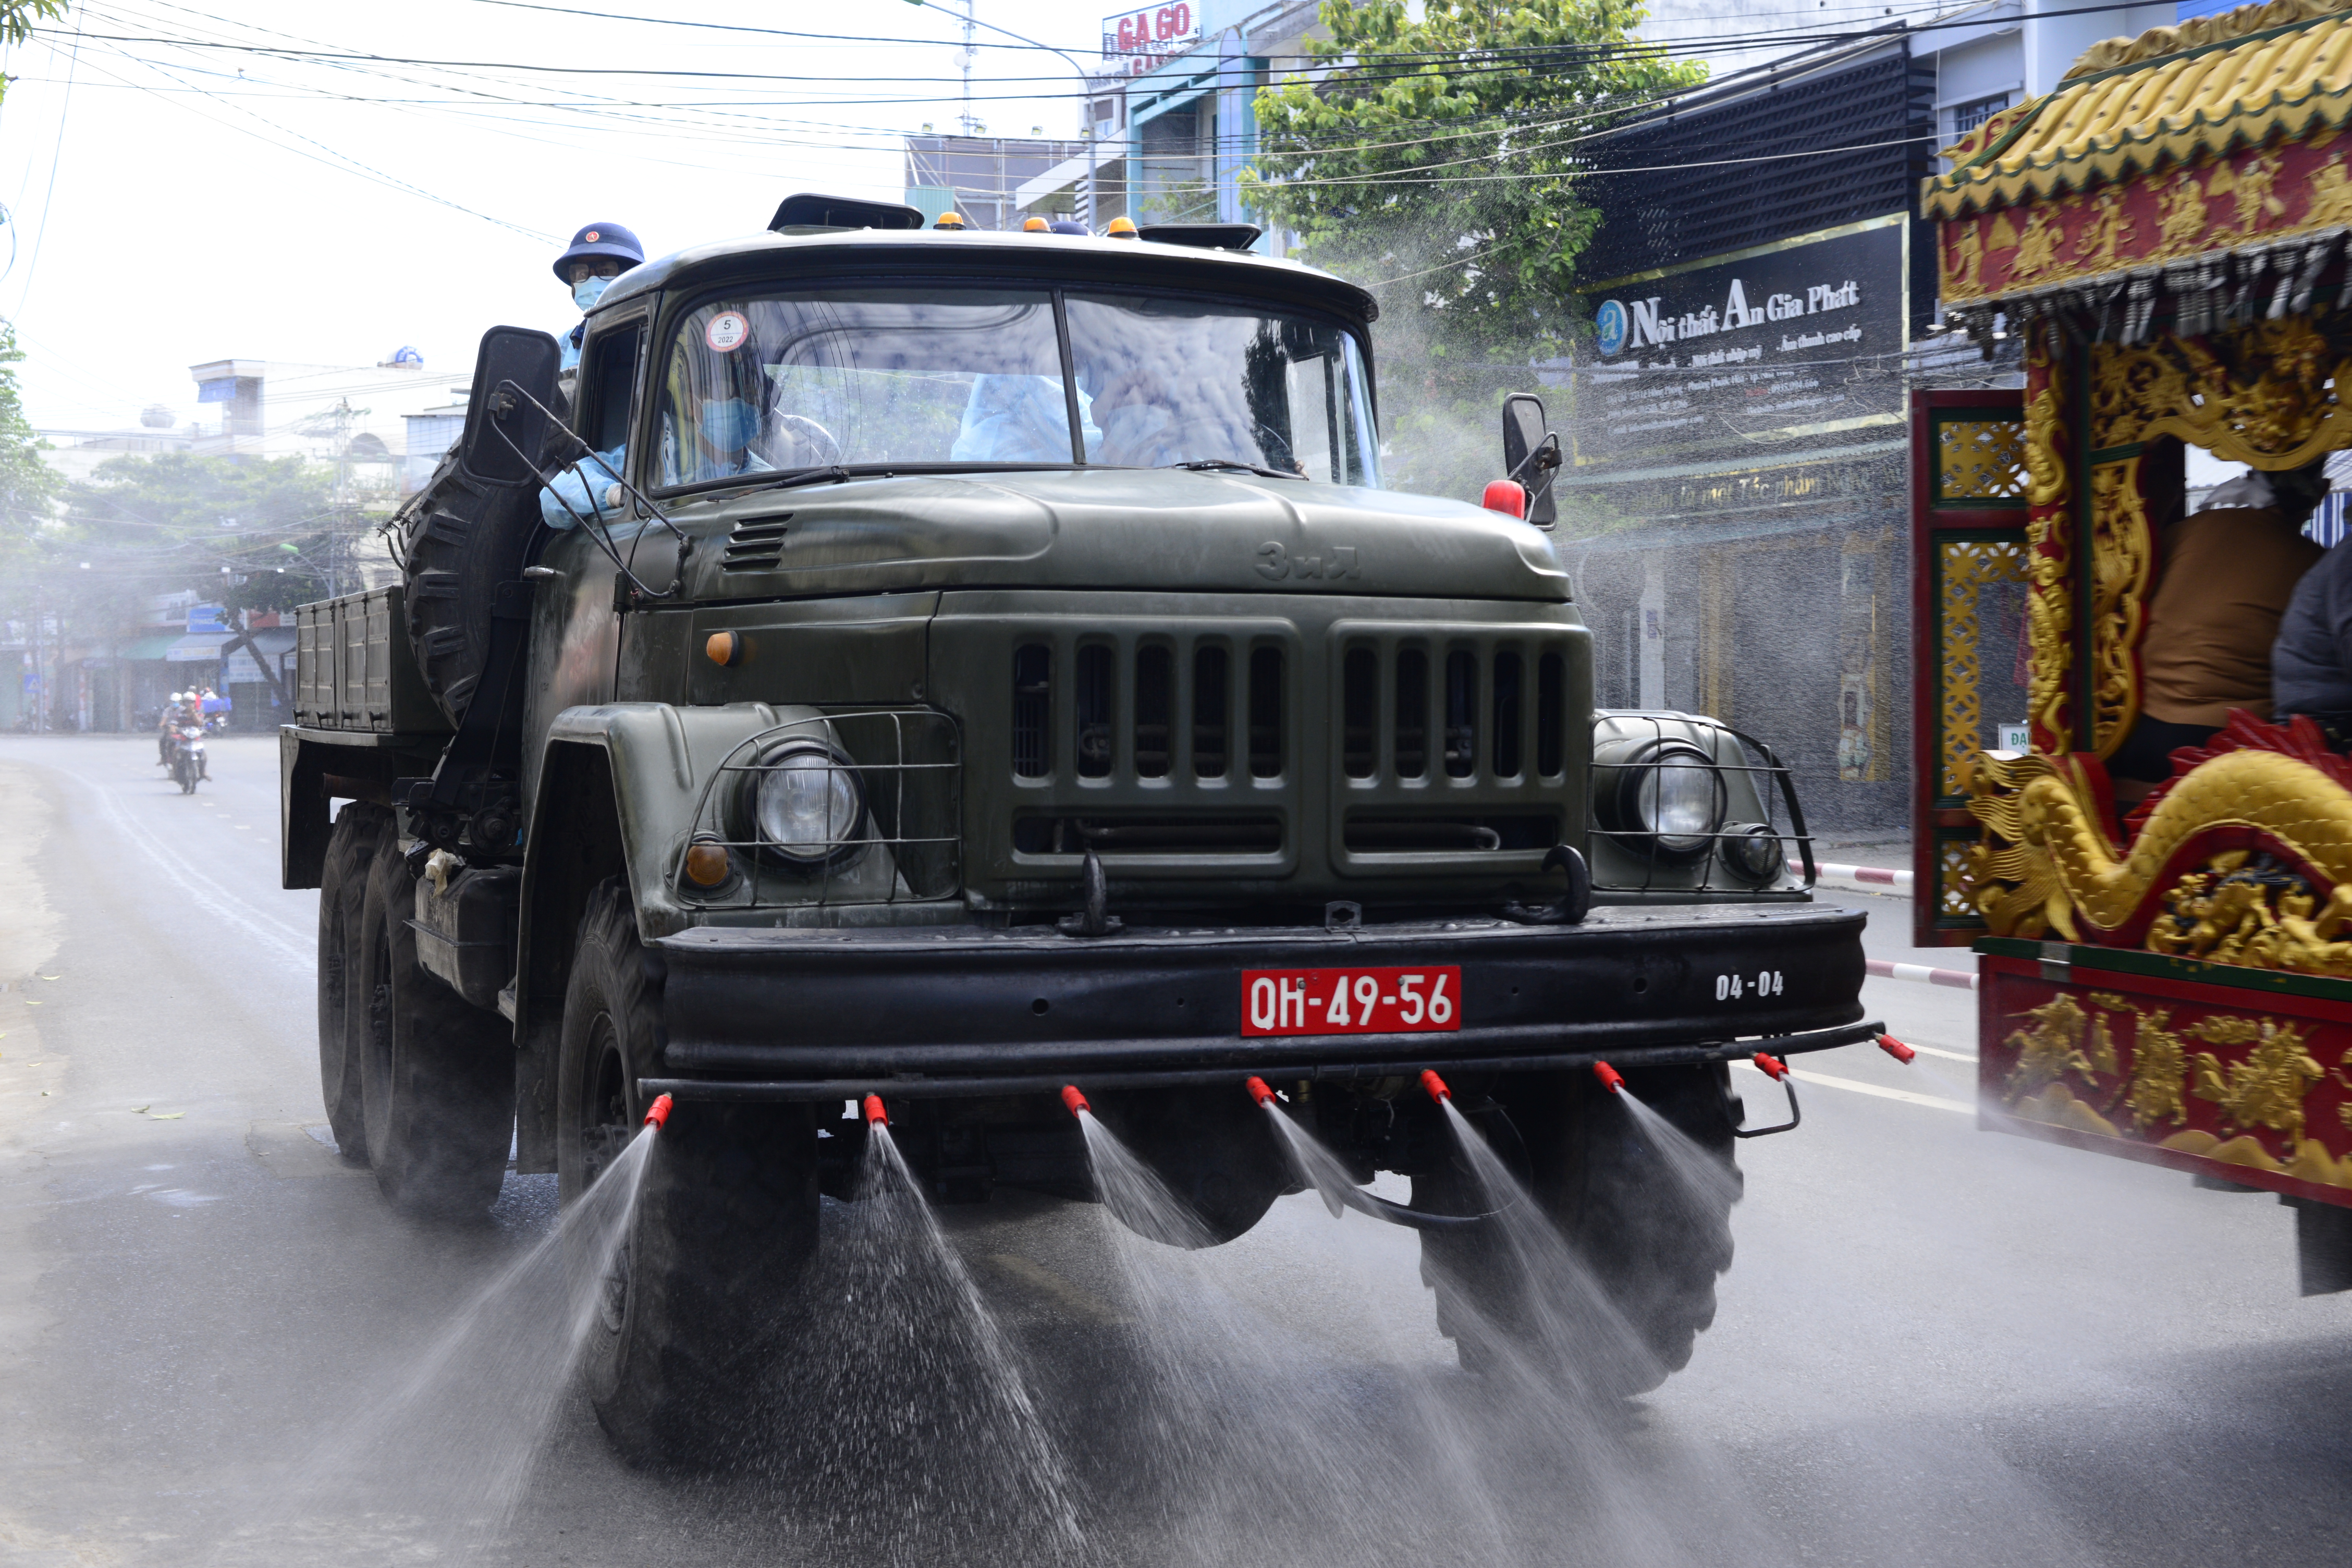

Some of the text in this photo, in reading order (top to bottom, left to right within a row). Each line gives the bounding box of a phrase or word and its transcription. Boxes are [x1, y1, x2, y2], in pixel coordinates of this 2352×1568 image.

[724, 320, 731, 330] 5
[1630, 279, 1860, 350] Nội thất An Gia Phát
[1251, 974, 1452, 1031] QH-49-56
[1716, 971, 1783, 1001] 04-04
